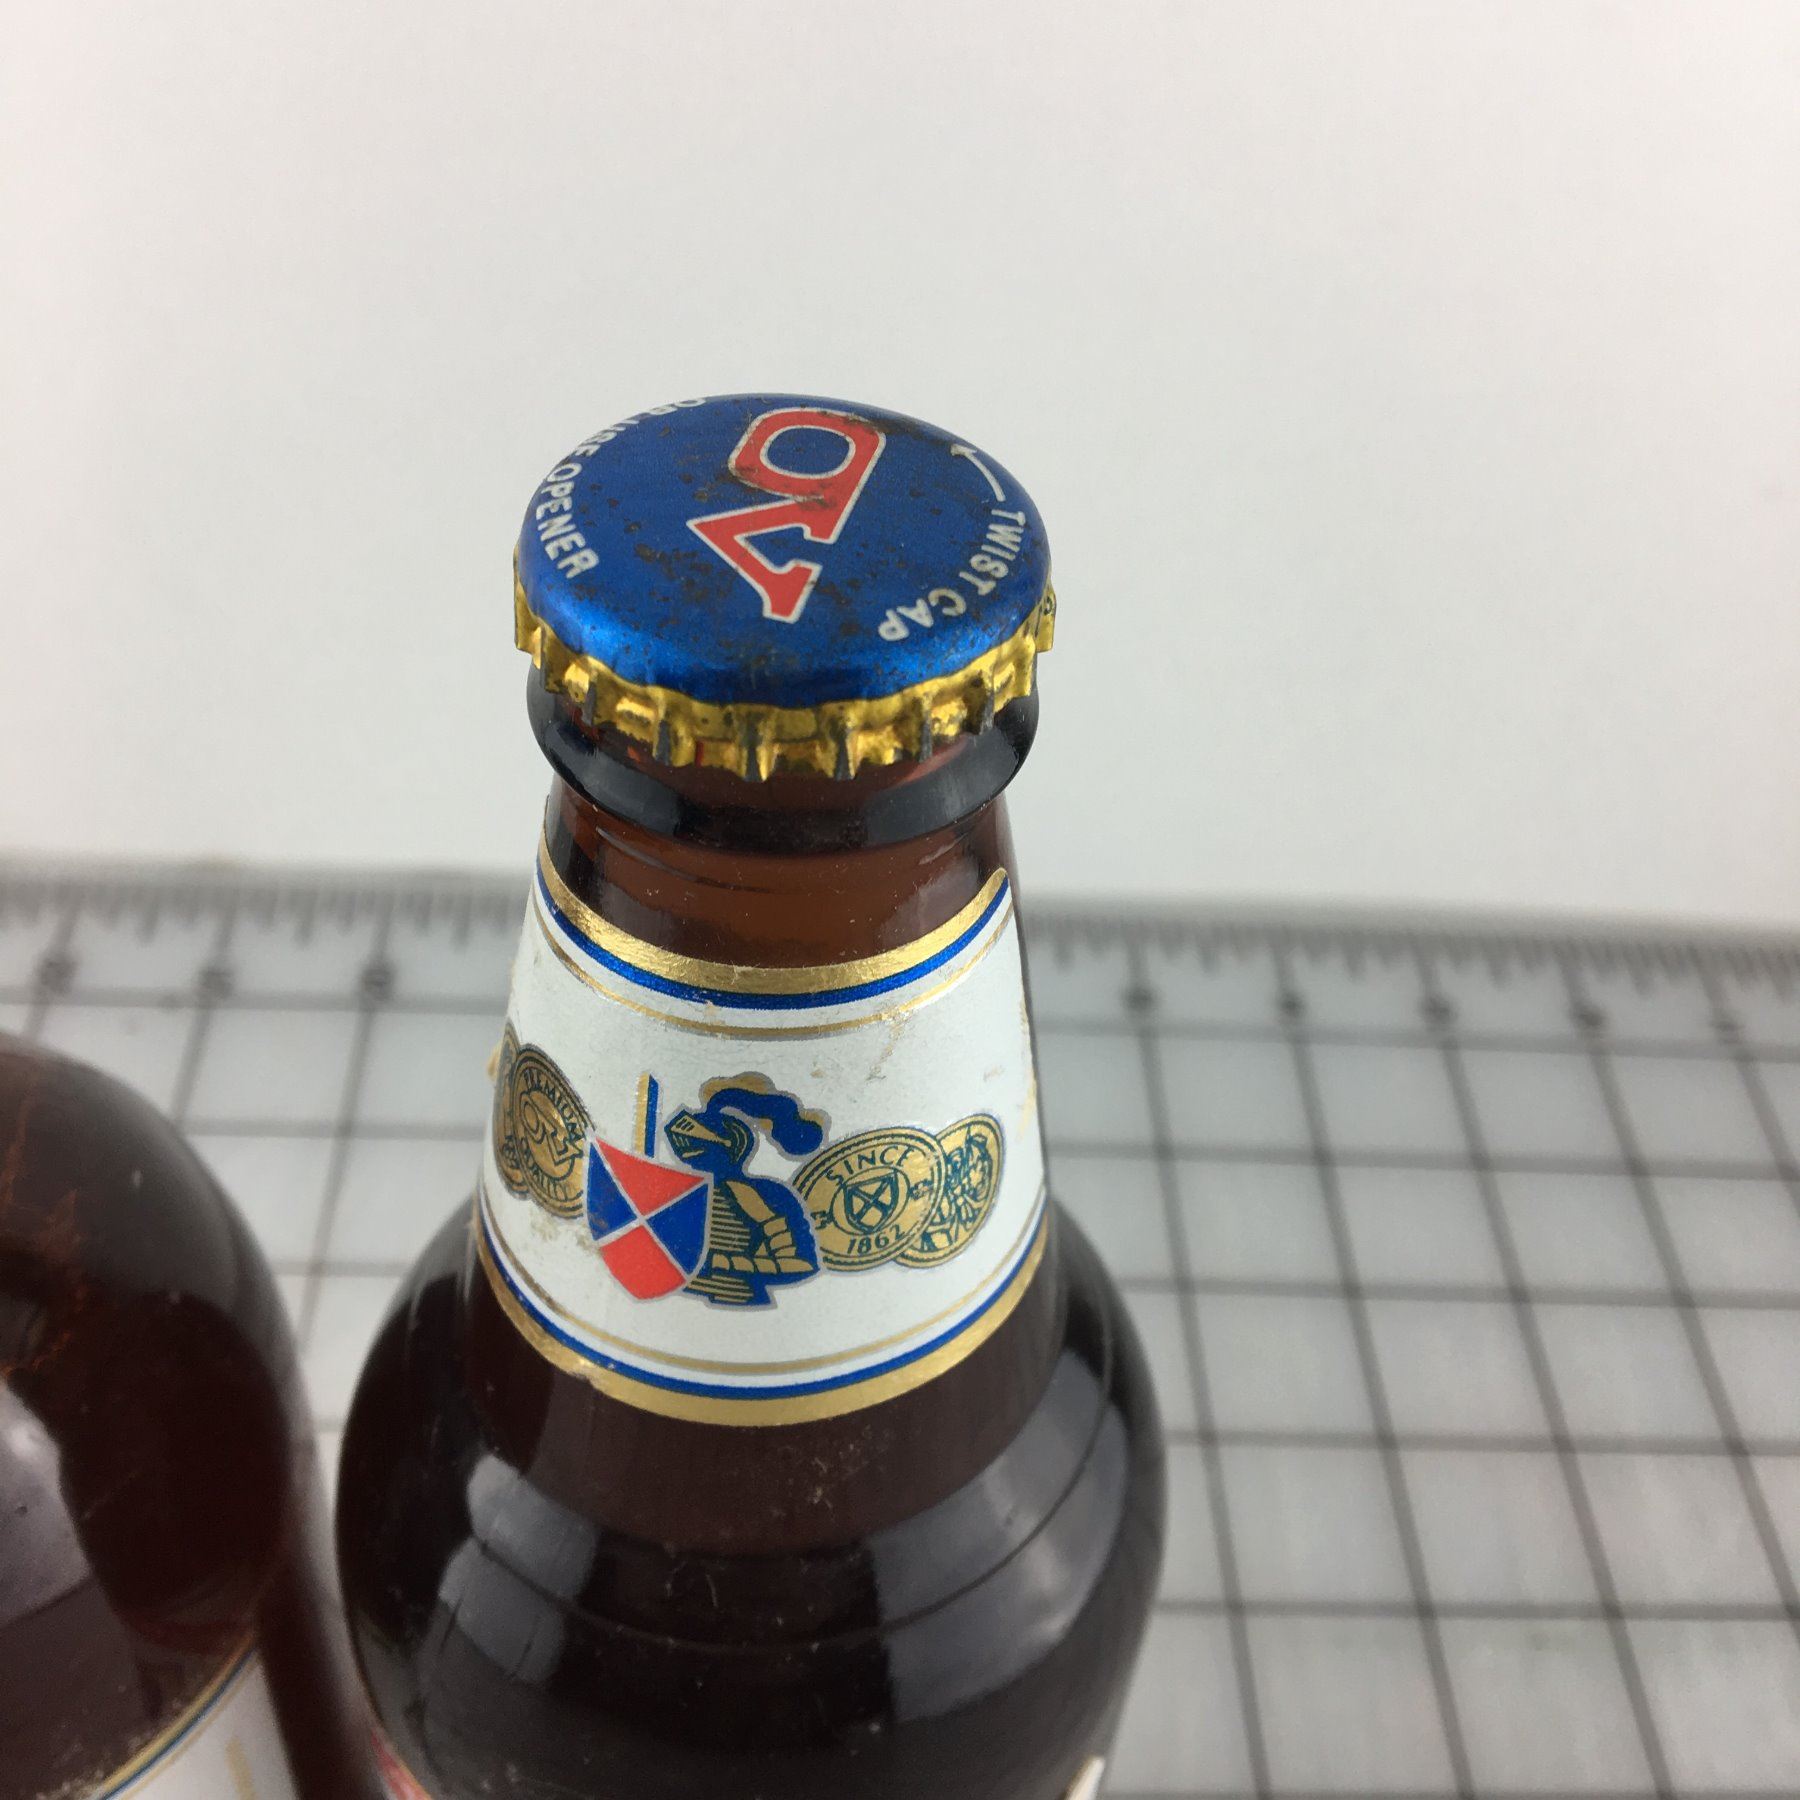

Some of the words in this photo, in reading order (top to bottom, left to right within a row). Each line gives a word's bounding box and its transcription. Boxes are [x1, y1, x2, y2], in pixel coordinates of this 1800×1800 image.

[536, 462, 599, 579] OPENER
[959, 509, 1026, 596] TWIST
[878, 588, 967, 641] CAP
[847, 1223, 906, 1255] 1862
